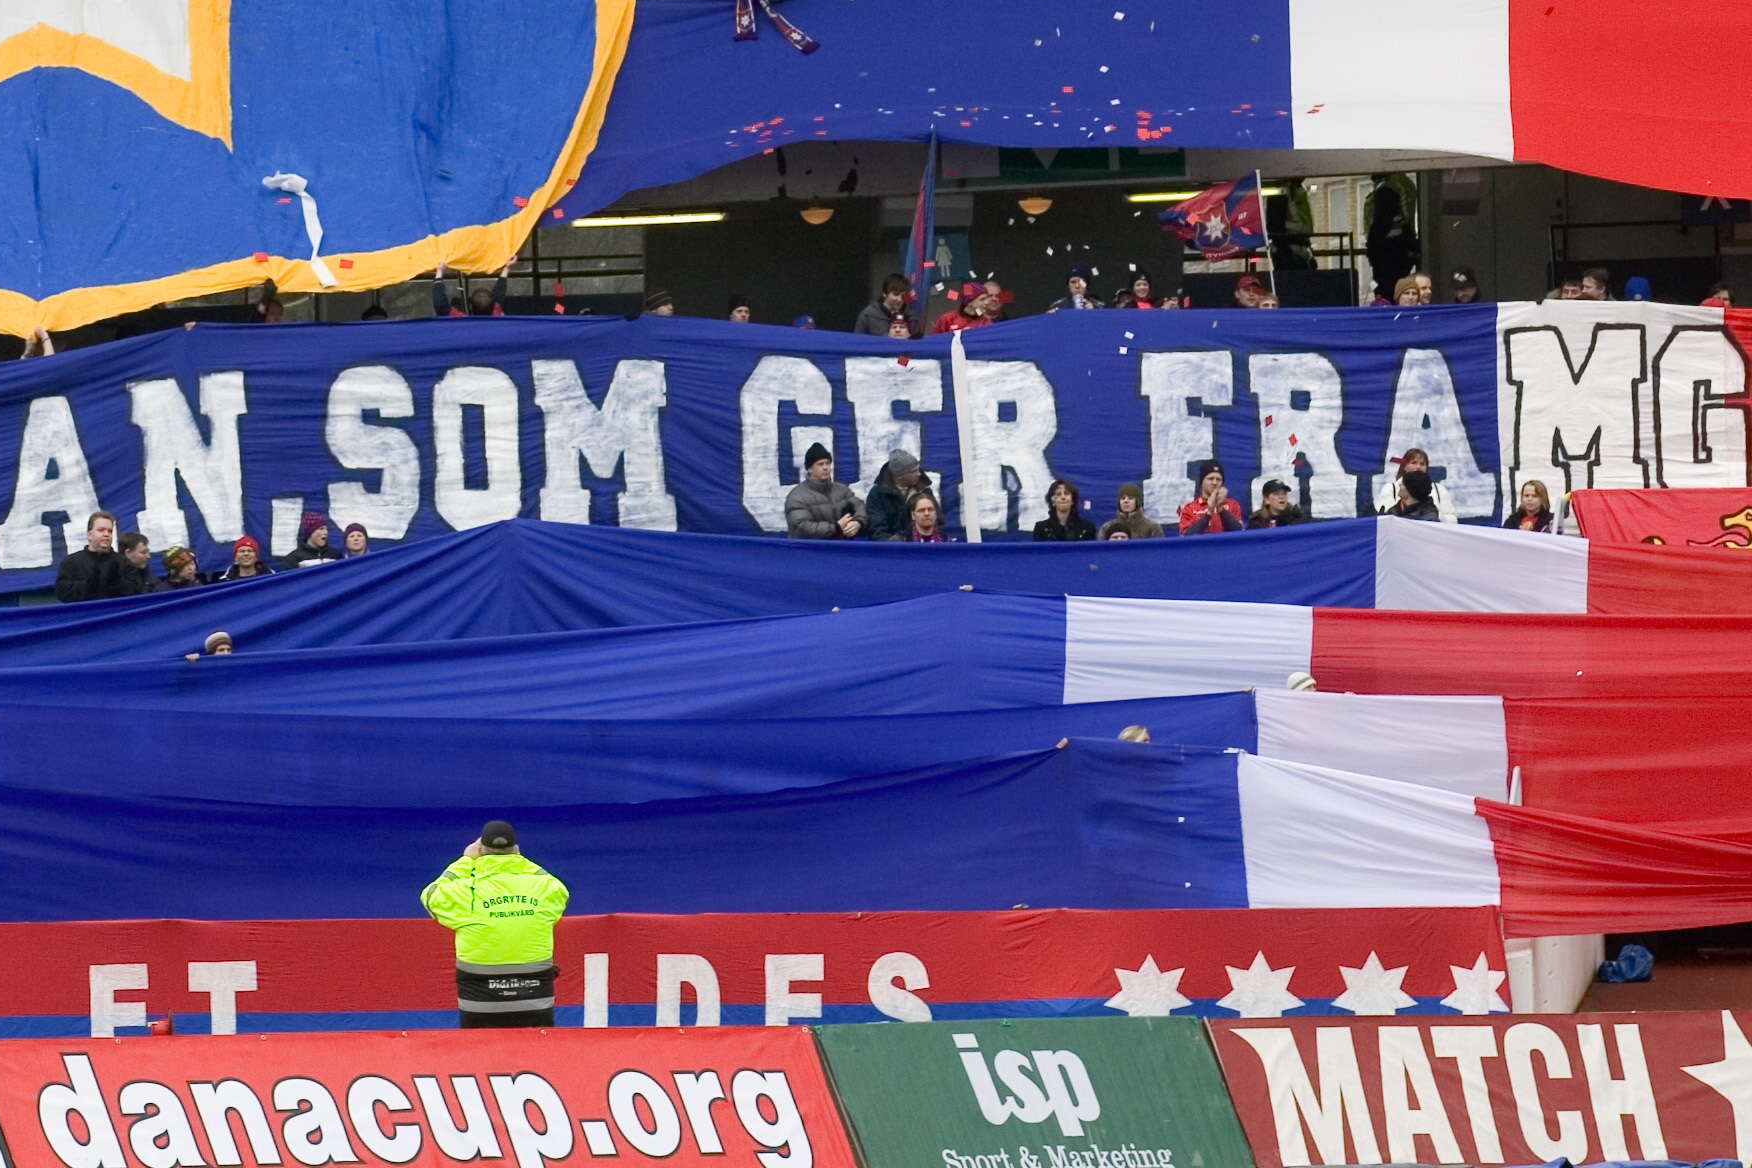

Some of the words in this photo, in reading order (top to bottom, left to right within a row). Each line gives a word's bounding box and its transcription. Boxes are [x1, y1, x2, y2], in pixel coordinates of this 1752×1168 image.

[325, 357, 678, 540] SOM
[740, 355, 1058, 532] GER
[89, 959, 258, 1037] ET
[36, 1052, 814, 1168] danacup.org
[951, 1033, 1101, 1137] isp
[1228, 1022, 1669, 1167] MATCH
[942, 1147, 1014, 1168] Sport
[1018, 1145, 1042, 1168] &
[1043, 1142, 1173, 1168] Marketing
